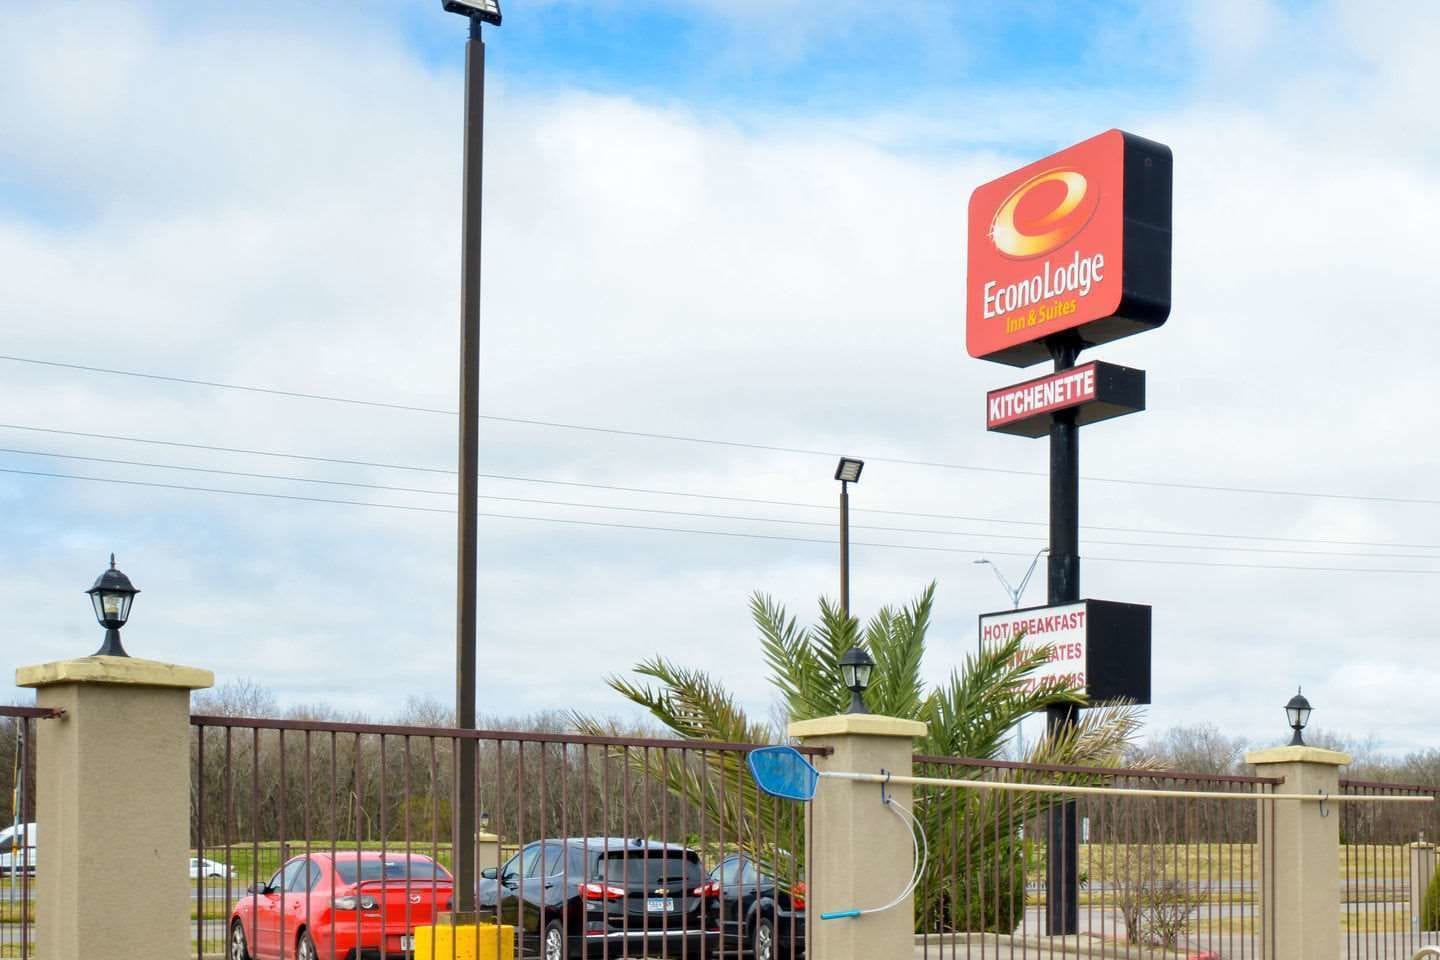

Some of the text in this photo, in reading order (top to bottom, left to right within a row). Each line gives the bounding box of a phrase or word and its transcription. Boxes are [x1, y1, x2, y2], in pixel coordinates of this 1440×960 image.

[1007, 299, 1076, 334] Inn & Suites
[990, 369, 1094, 421] KITCHENETTE
[984, 611, 1085, 641] HOT BREAKFAST
